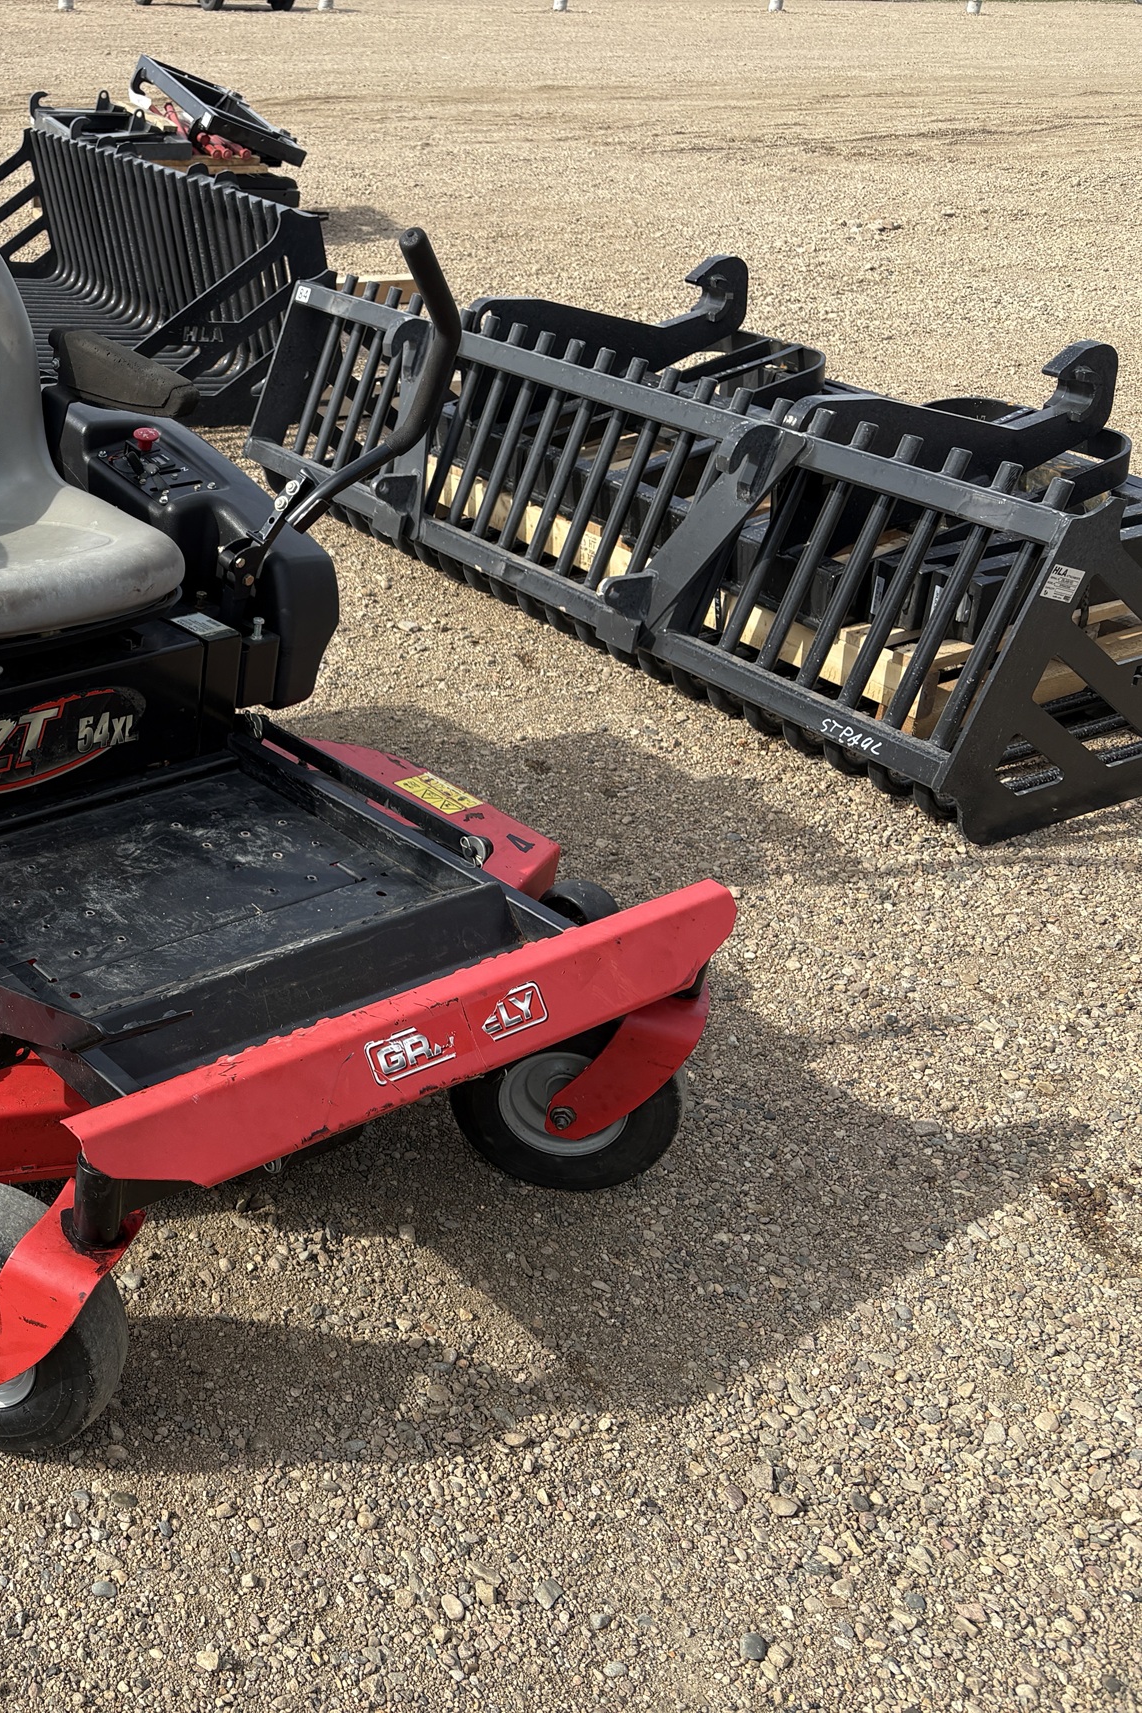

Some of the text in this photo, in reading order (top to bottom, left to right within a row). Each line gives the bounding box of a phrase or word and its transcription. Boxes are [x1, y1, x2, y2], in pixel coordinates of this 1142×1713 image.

[183, 326, 224, 343] HLA
[1052, 565, 1069, 577] HLA
[76, 711, 139, 753] 54XL
